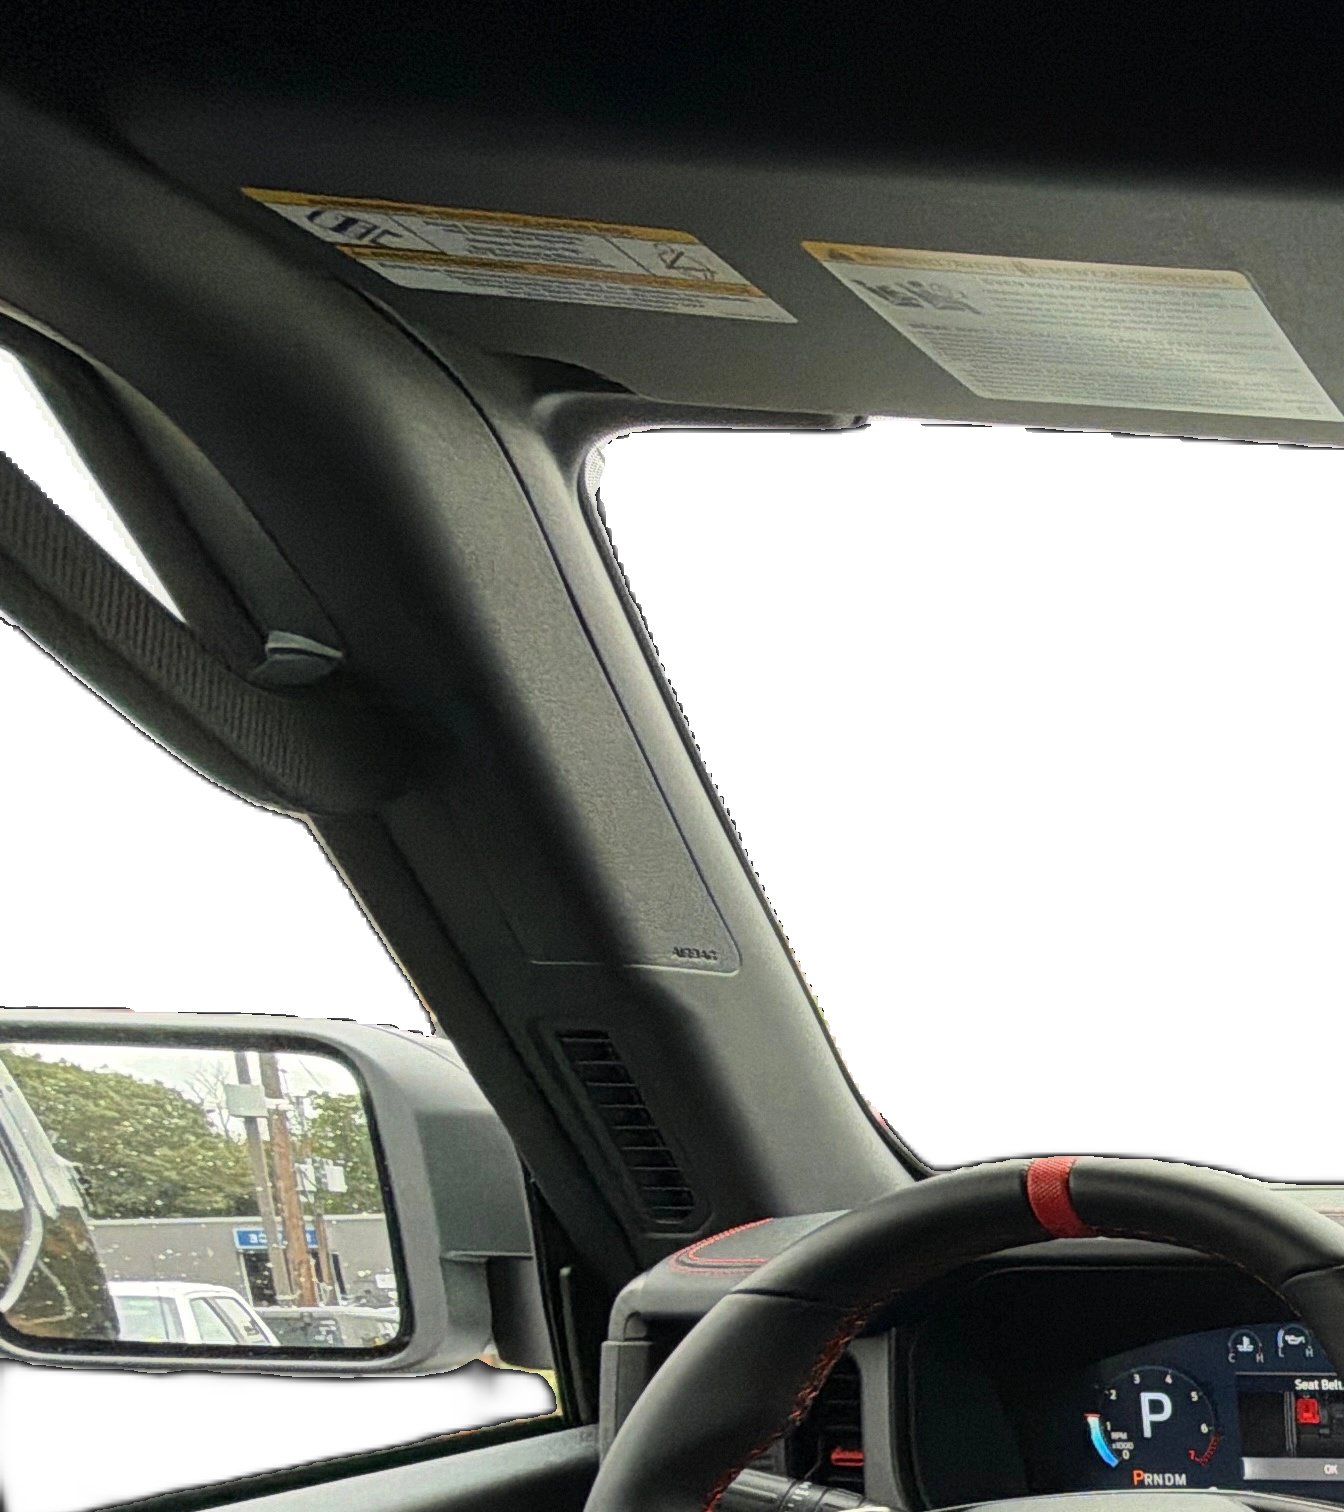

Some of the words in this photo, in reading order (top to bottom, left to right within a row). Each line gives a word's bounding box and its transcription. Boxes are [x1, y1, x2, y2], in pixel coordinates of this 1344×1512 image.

[1133, 1374, 1140, 1384] 3
[1165, 1374, 1173, 1384] 4
[1294, 1379, 1320, 1390] Seat
[1110, 1390, 1117, 1400] 2
[1190, 1391, 1198, 1401] 5
[1140, 1391, 1173, 1438] P
[1200, 1423, 1209, 1433] 6
[1323, 1464, 1338, 1475] OK
